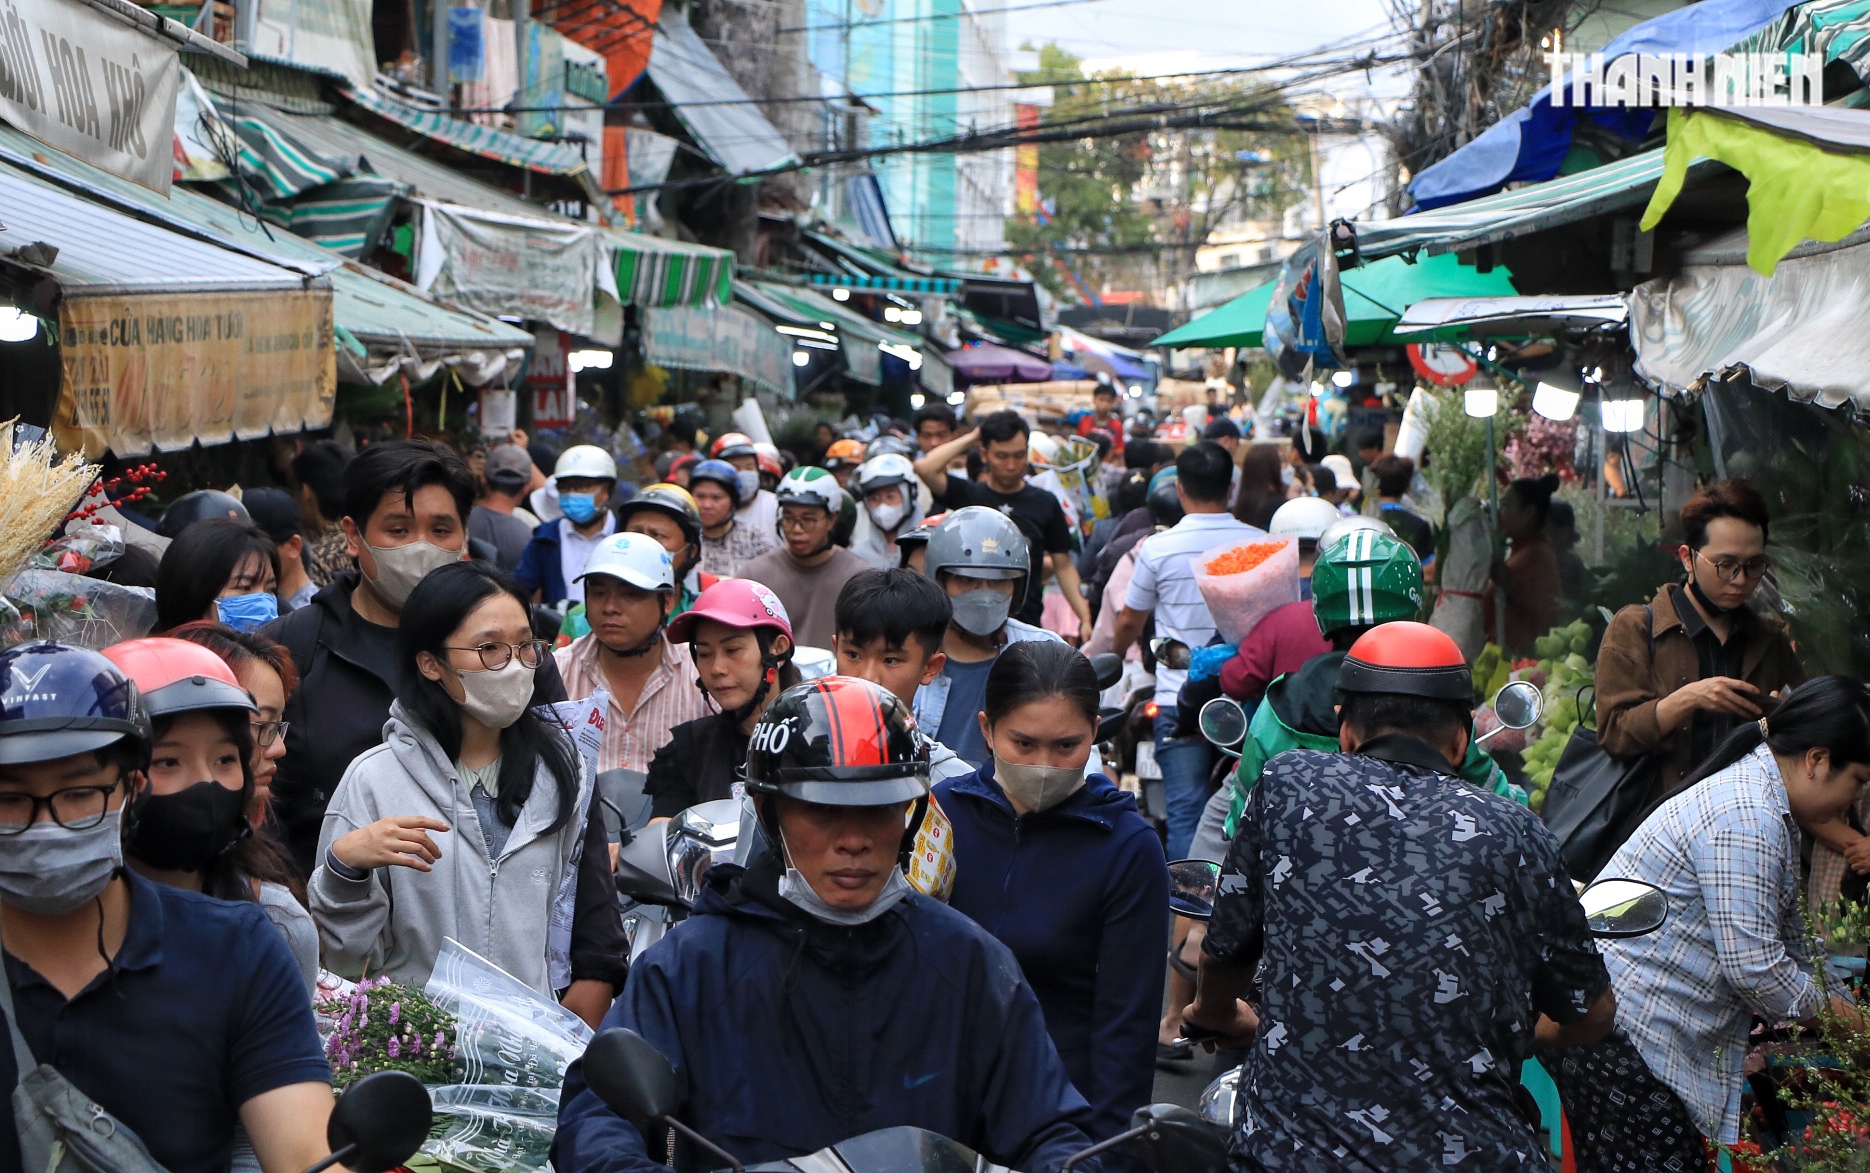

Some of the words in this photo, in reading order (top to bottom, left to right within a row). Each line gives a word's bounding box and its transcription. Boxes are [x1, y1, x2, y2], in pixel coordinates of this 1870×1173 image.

[40, 28, 100, 140] HOA
[101, 52, 147, 160] KHÔ
[110, 307, 141, 347] CỬA
[146, 310, 184, 345] HÀNG
[2, 692, 57, 704] VINFAST
[751, 716, 799, 754] PHỐ
